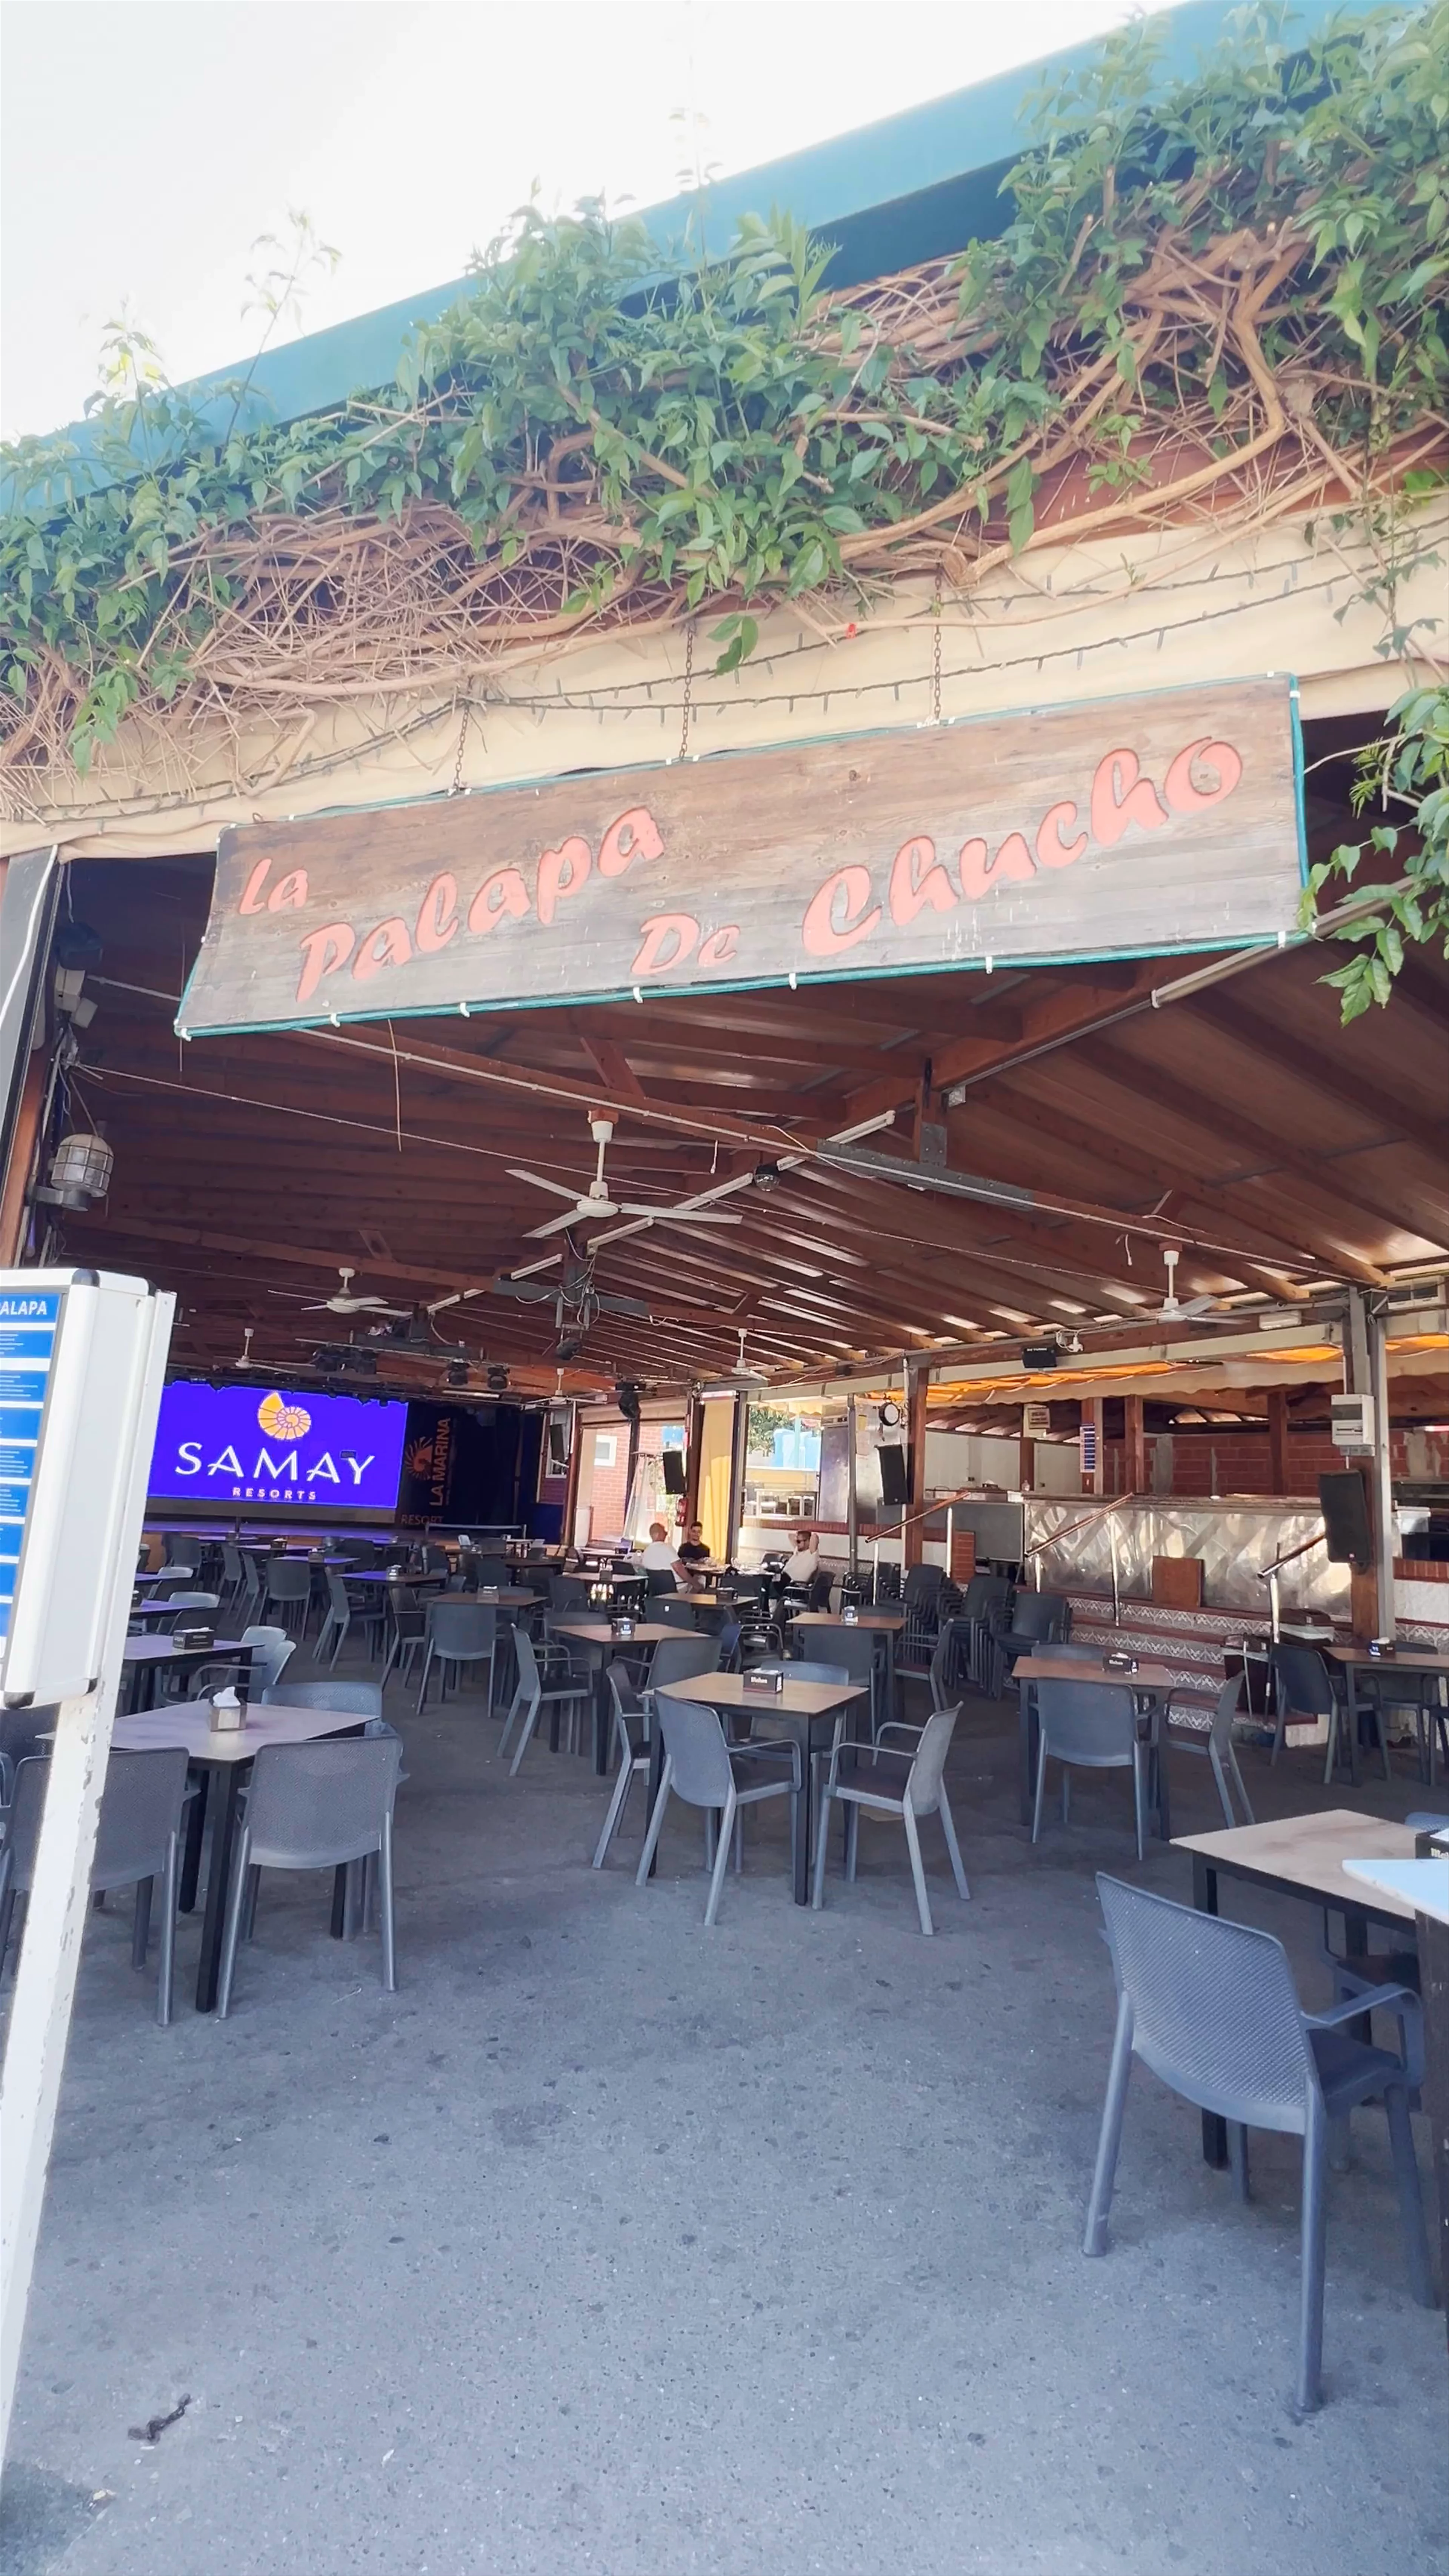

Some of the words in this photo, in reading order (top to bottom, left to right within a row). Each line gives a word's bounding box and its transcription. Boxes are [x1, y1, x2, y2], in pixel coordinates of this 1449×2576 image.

[238, 858, 309, 915] La
[295, 807, 665, 1003] Palapa
[631, 912, 741, 976] De
[801, 736, 1243, 956] Chucho
[0, 1301, 47, 1315] ALAPA
[175, 1442, 375, 1485] SAMAY
[432, 1418, 451, 1481] MARINA
[232, 1487, 317, 1501] RESORTS
[429, 1485, 444, 1506] LA
